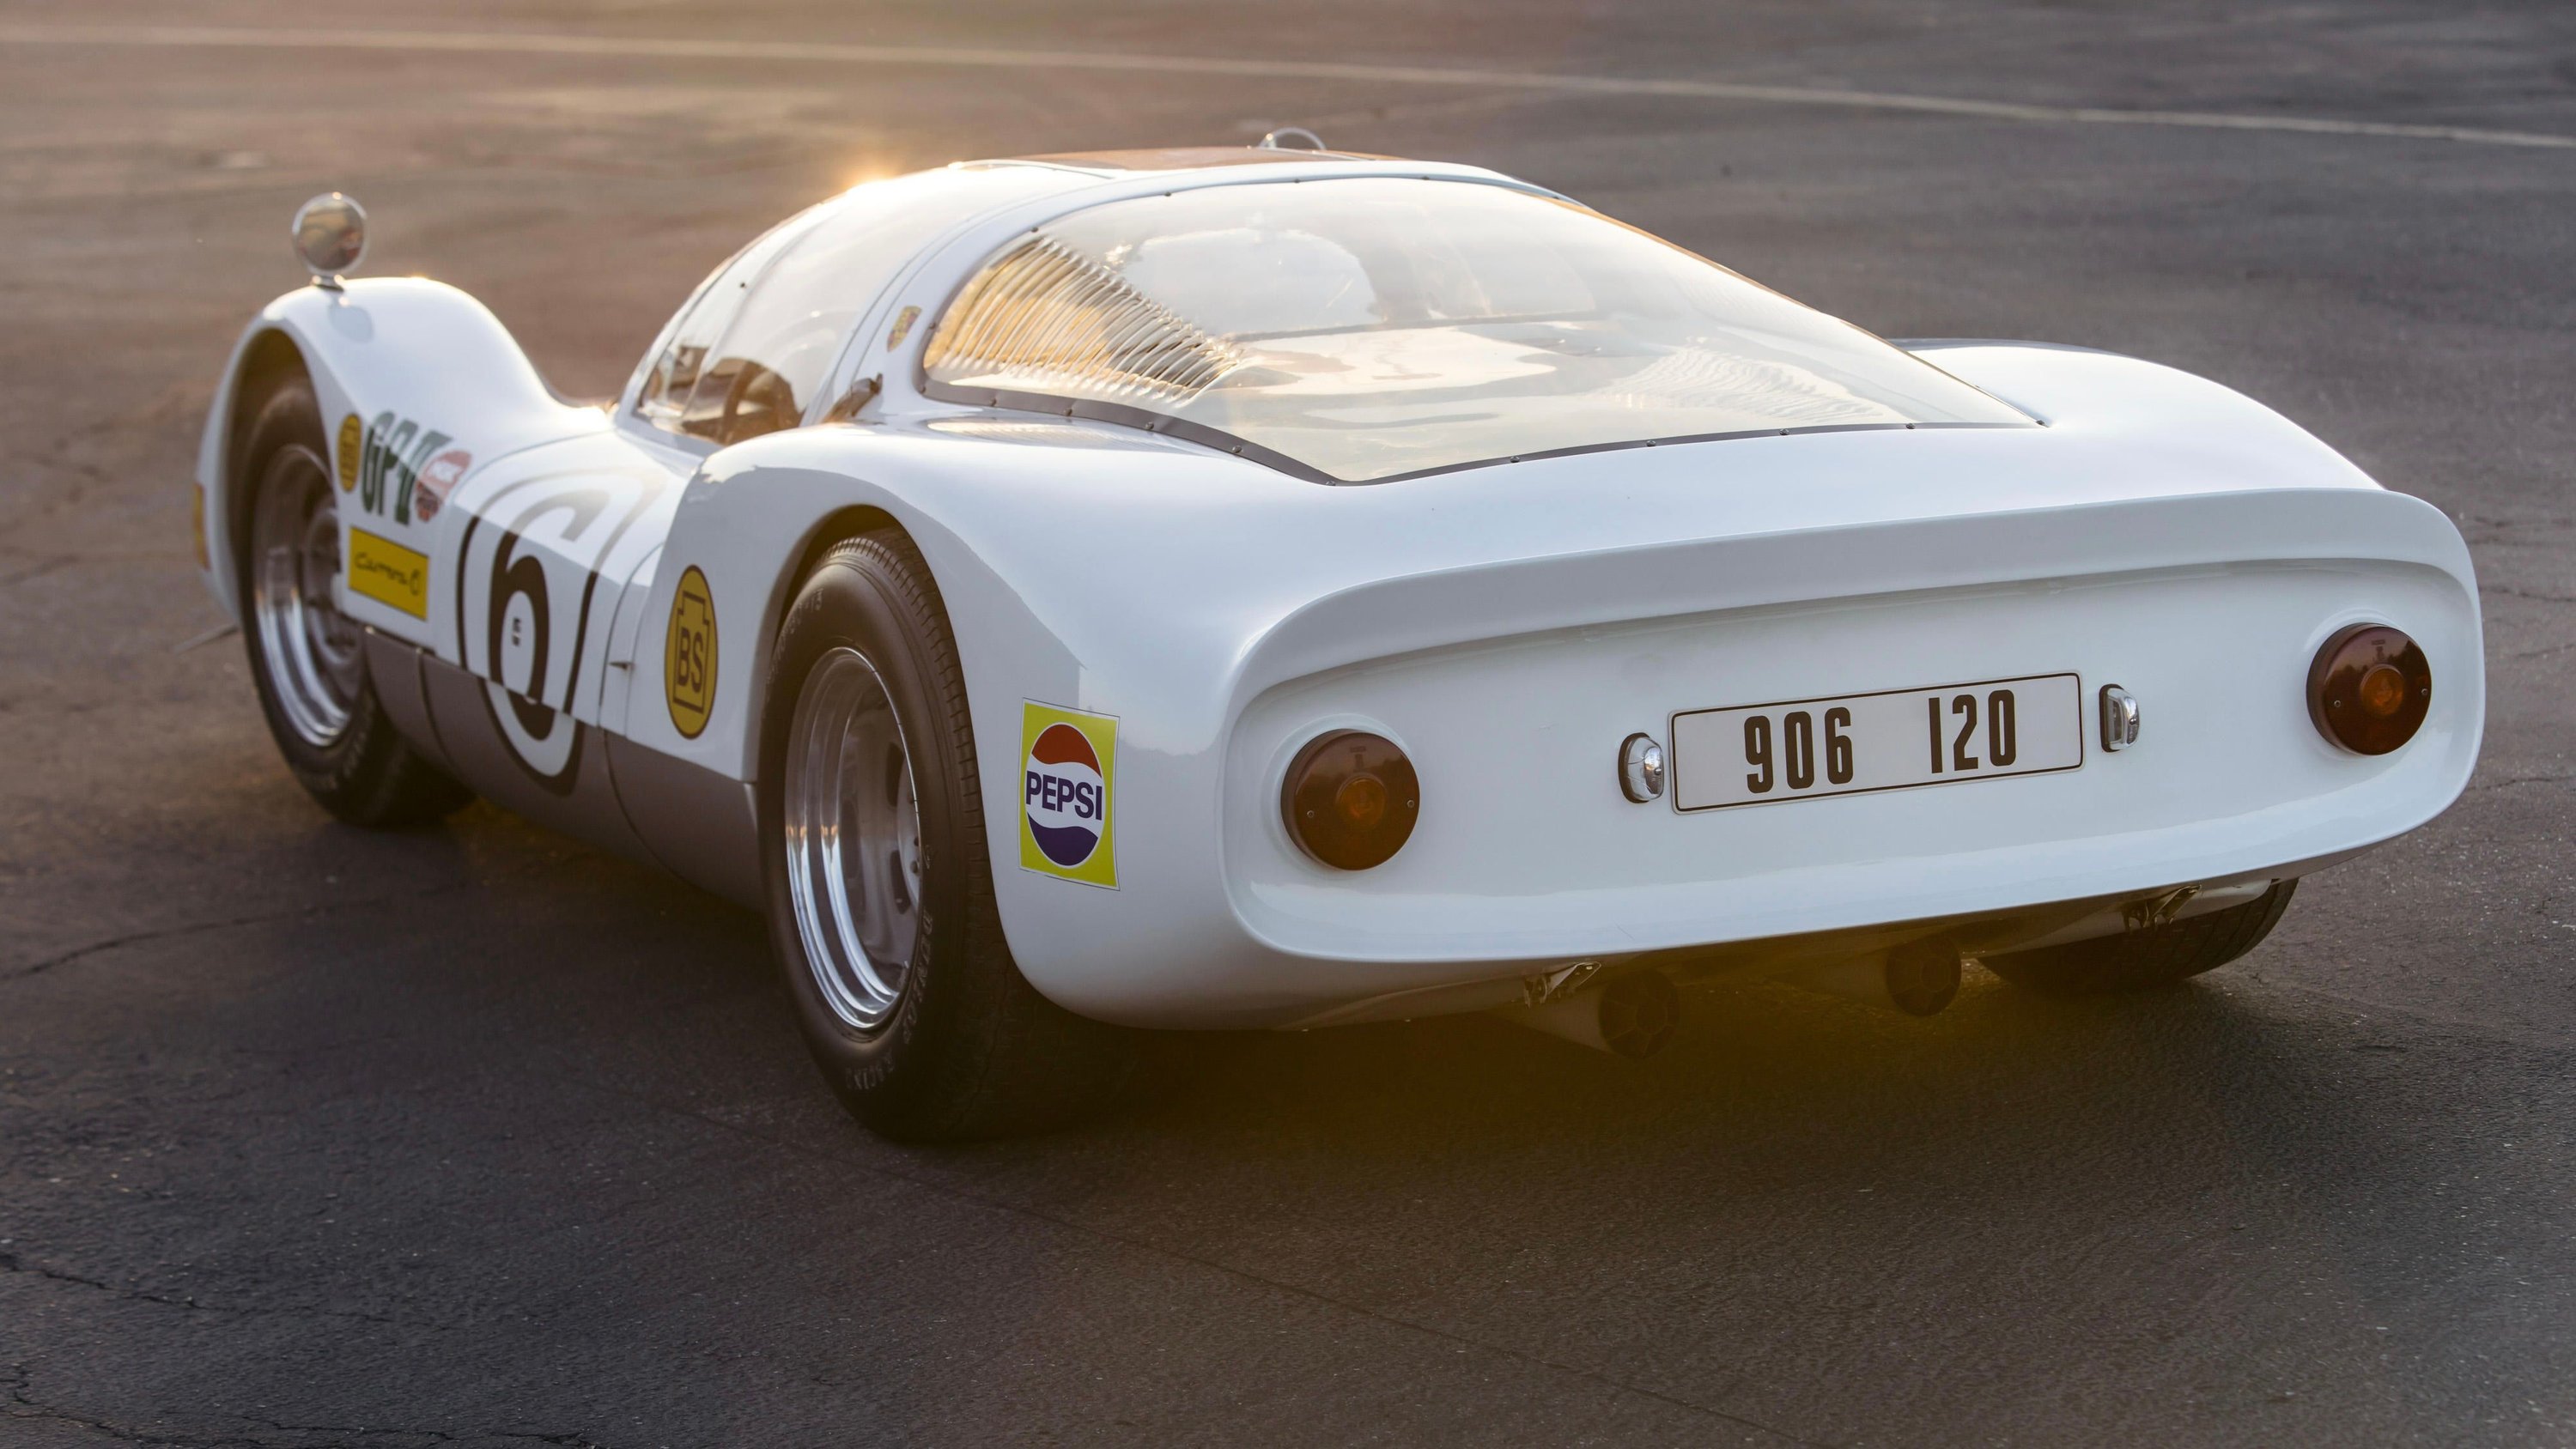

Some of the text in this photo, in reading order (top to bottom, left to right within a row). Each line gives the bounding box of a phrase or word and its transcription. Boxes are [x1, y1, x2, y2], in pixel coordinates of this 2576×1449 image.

[489, 488, 611, 741] 6
[677, 627, 703, 693] BS
[1744, 689, 2016, 794] 906 120
[1026, 770, 1103, 821] PEPSI
[903, 911, 933, 1044] DUNLOP
